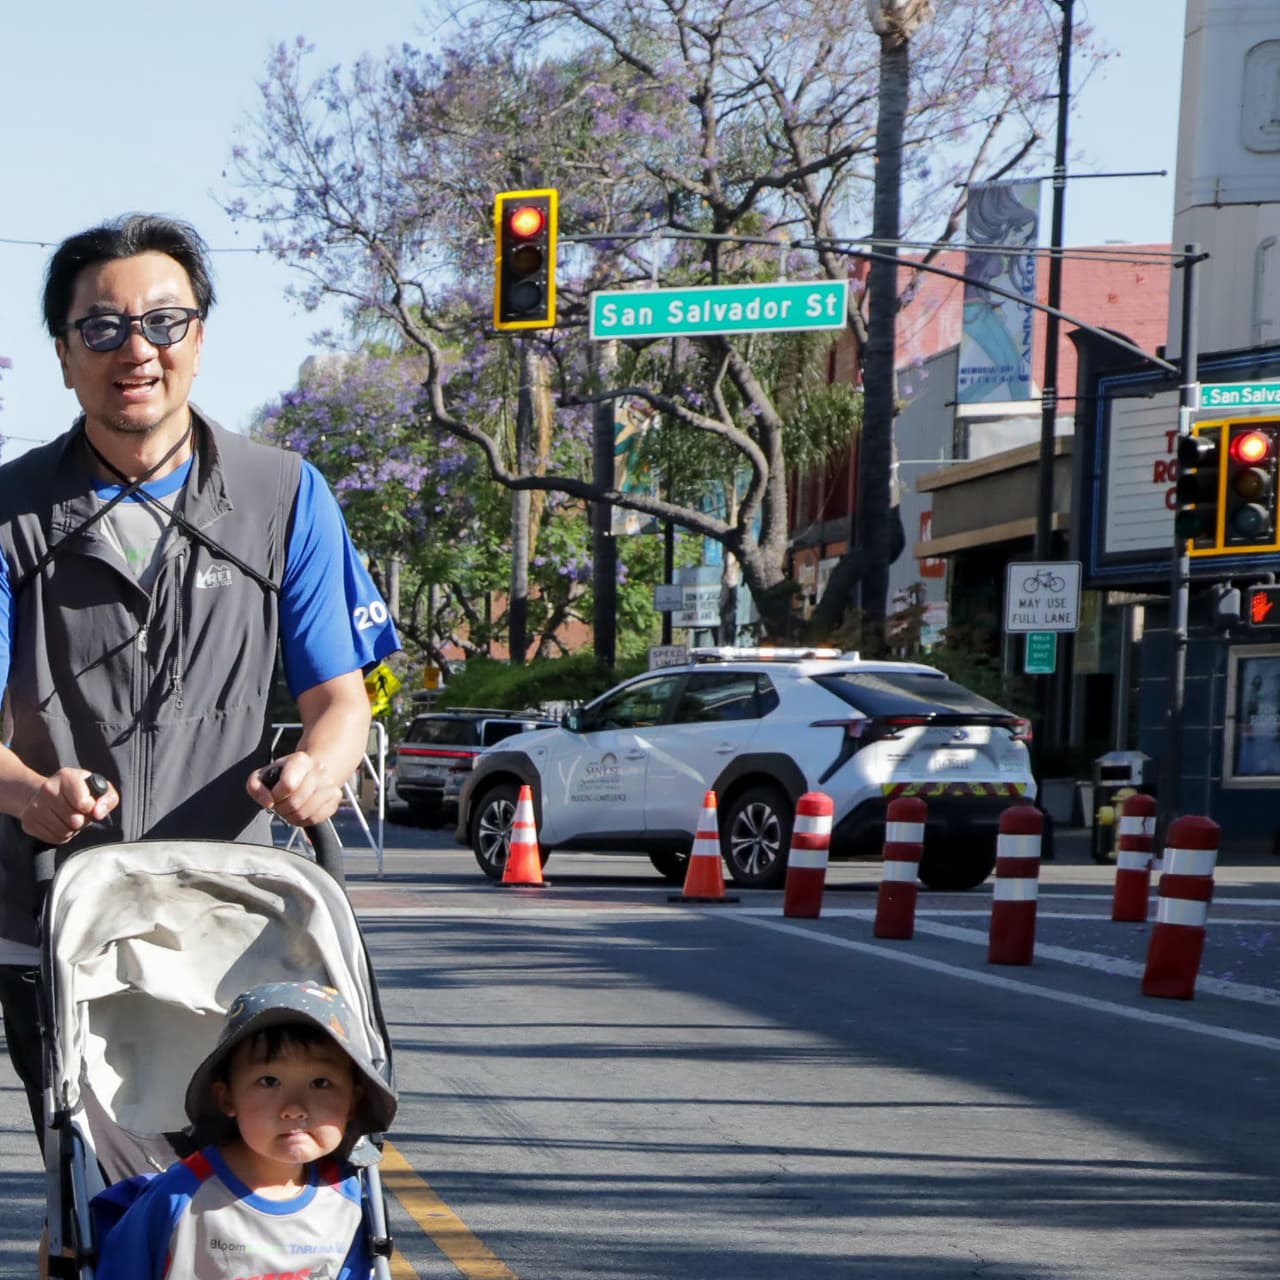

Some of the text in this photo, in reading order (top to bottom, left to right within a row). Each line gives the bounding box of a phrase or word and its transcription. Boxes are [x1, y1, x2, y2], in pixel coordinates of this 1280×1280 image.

[601, 292, 837, 327] San Salvador St
[1210, 388, 1240, 404] San
[1242, 387, 1280, 403] Salva
[1018, 598, 1067, 609] MAY USE
[1012, 612, 1072, 624] FULL LANE
